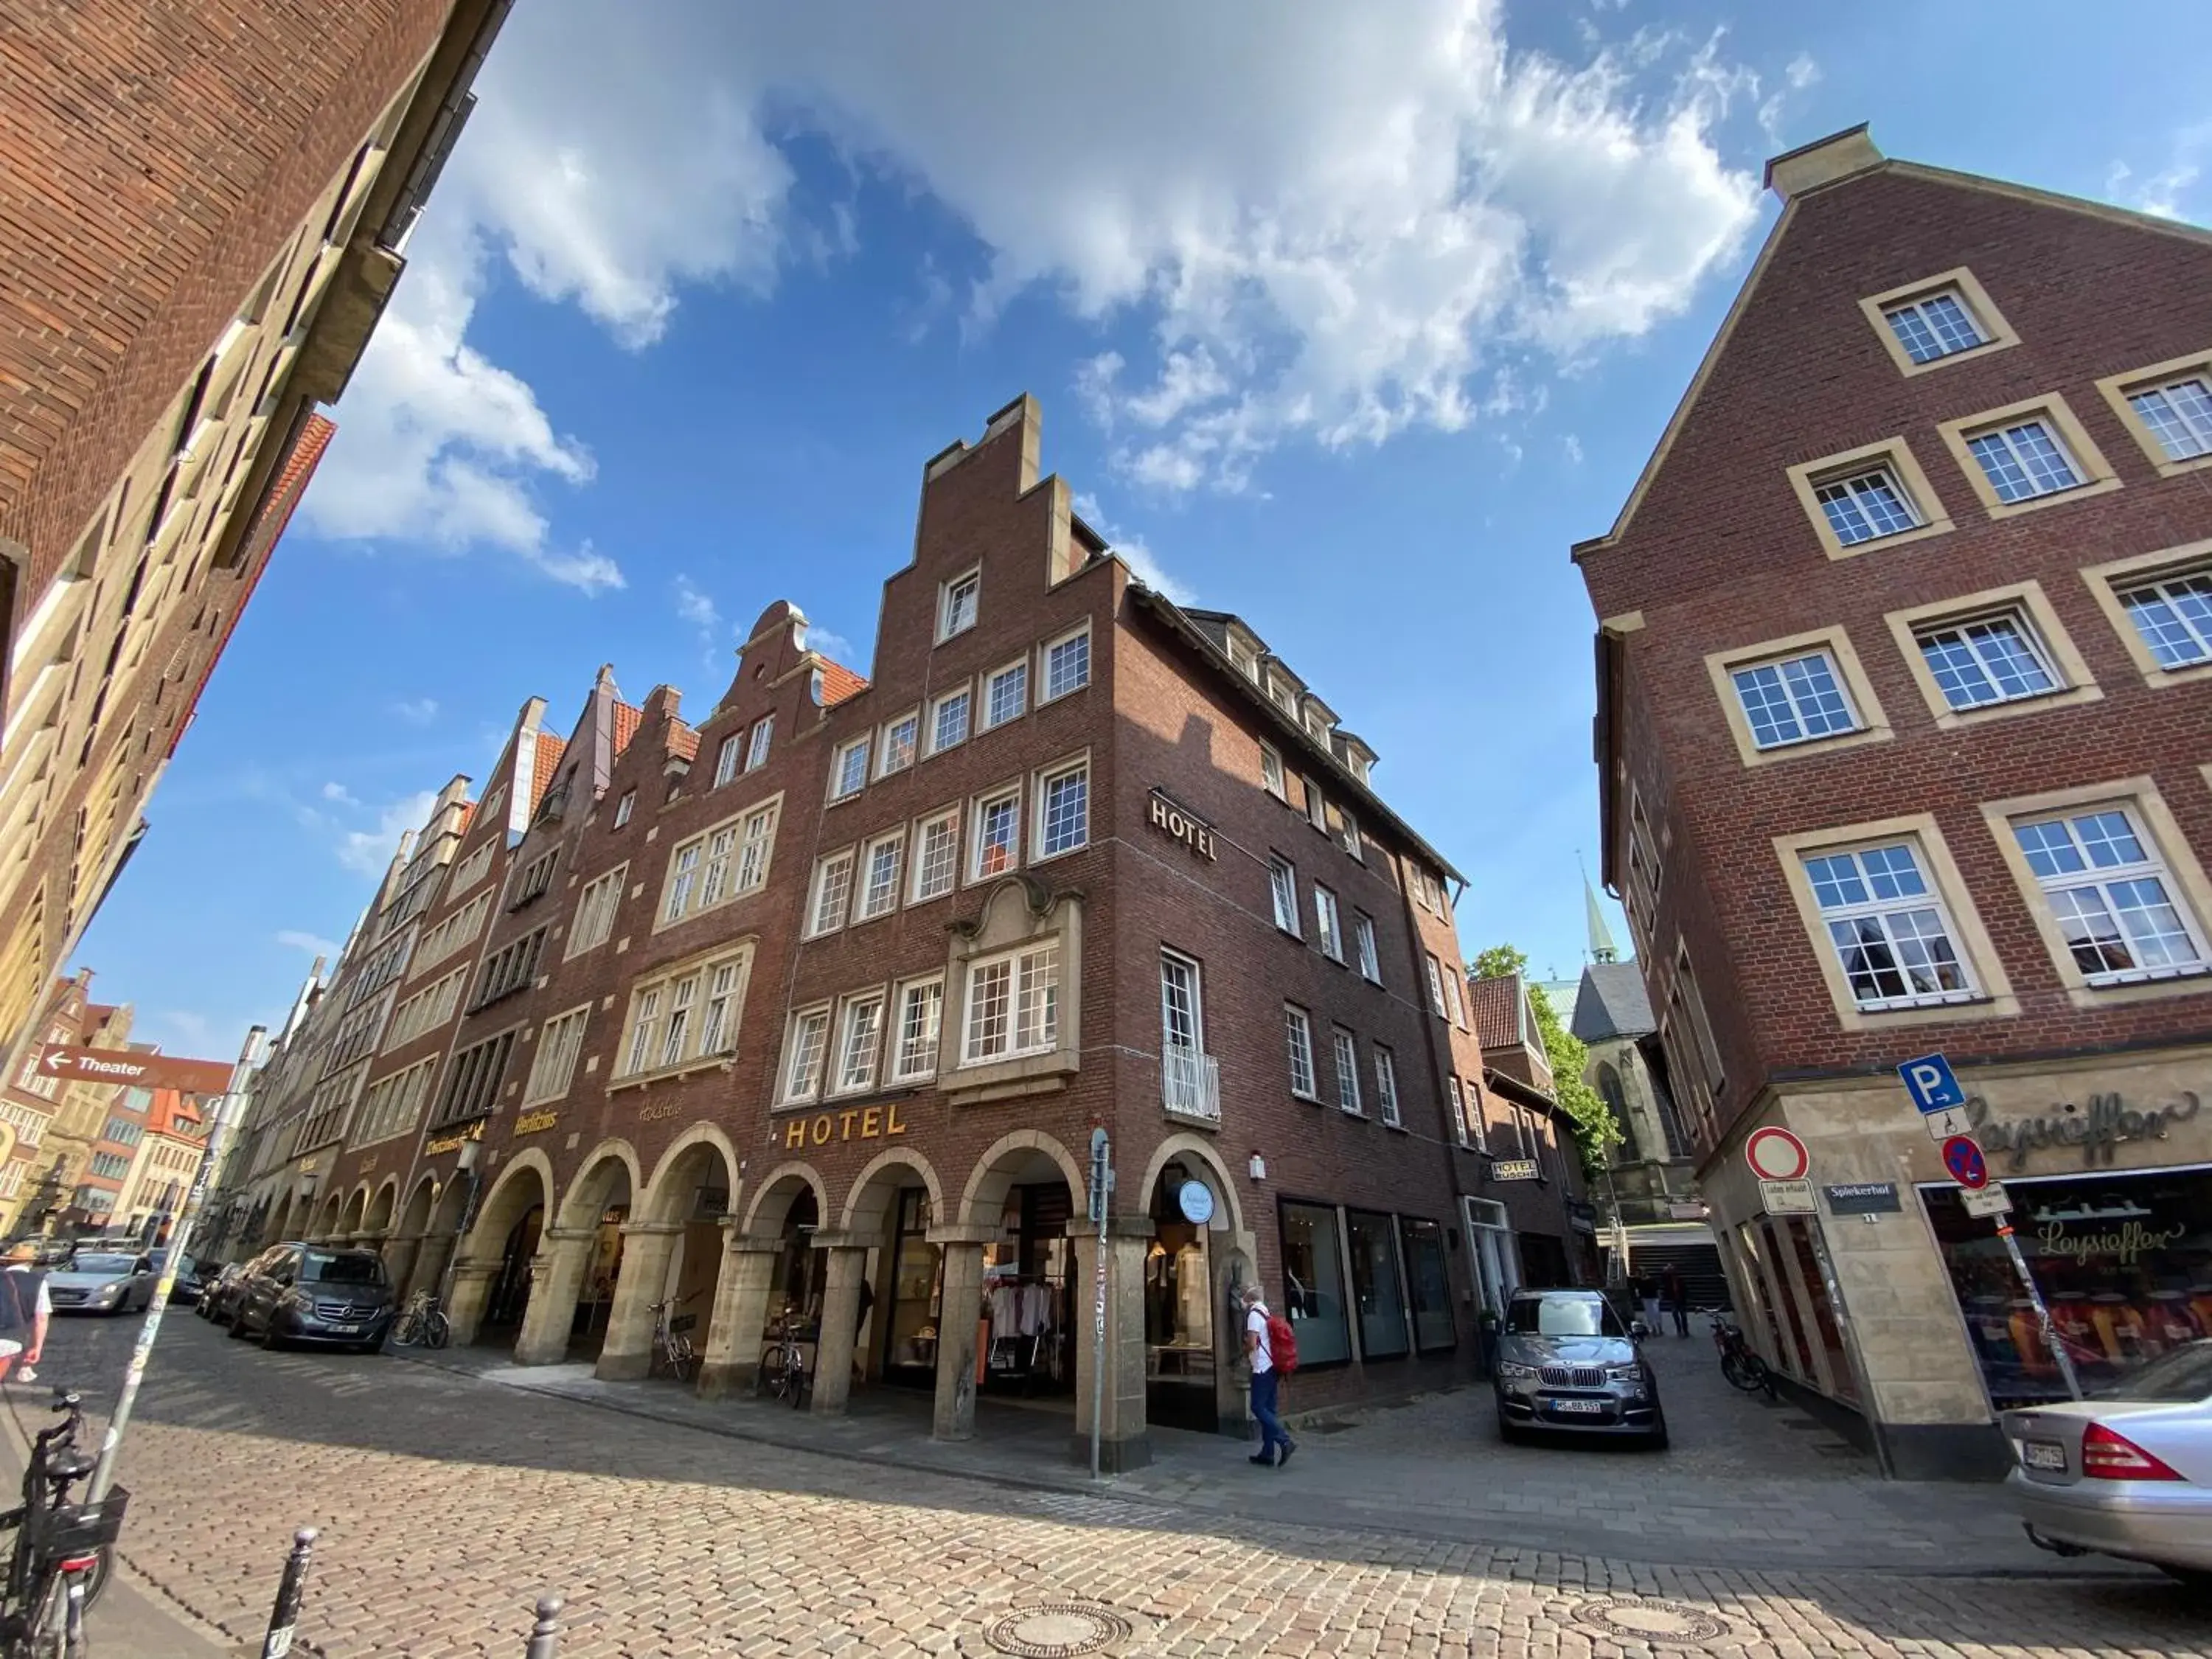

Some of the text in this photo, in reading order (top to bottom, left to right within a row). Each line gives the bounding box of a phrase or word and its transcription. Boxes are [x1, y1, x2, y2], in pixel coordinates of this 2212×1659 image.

[1152, 800, 1217, 861] HOTEL
[78, 1057, 145, 1076] Theater
[1910, 1065, 1941, 1105] P
[786, 1105, 906, 1150] HOTEL
[1494, 1162, 1536, 1171] HOTEL
[1830, 1185, 1890, 1198] Spiekerhof
[2037, 1220, 2186, 1267] Leysieffer
